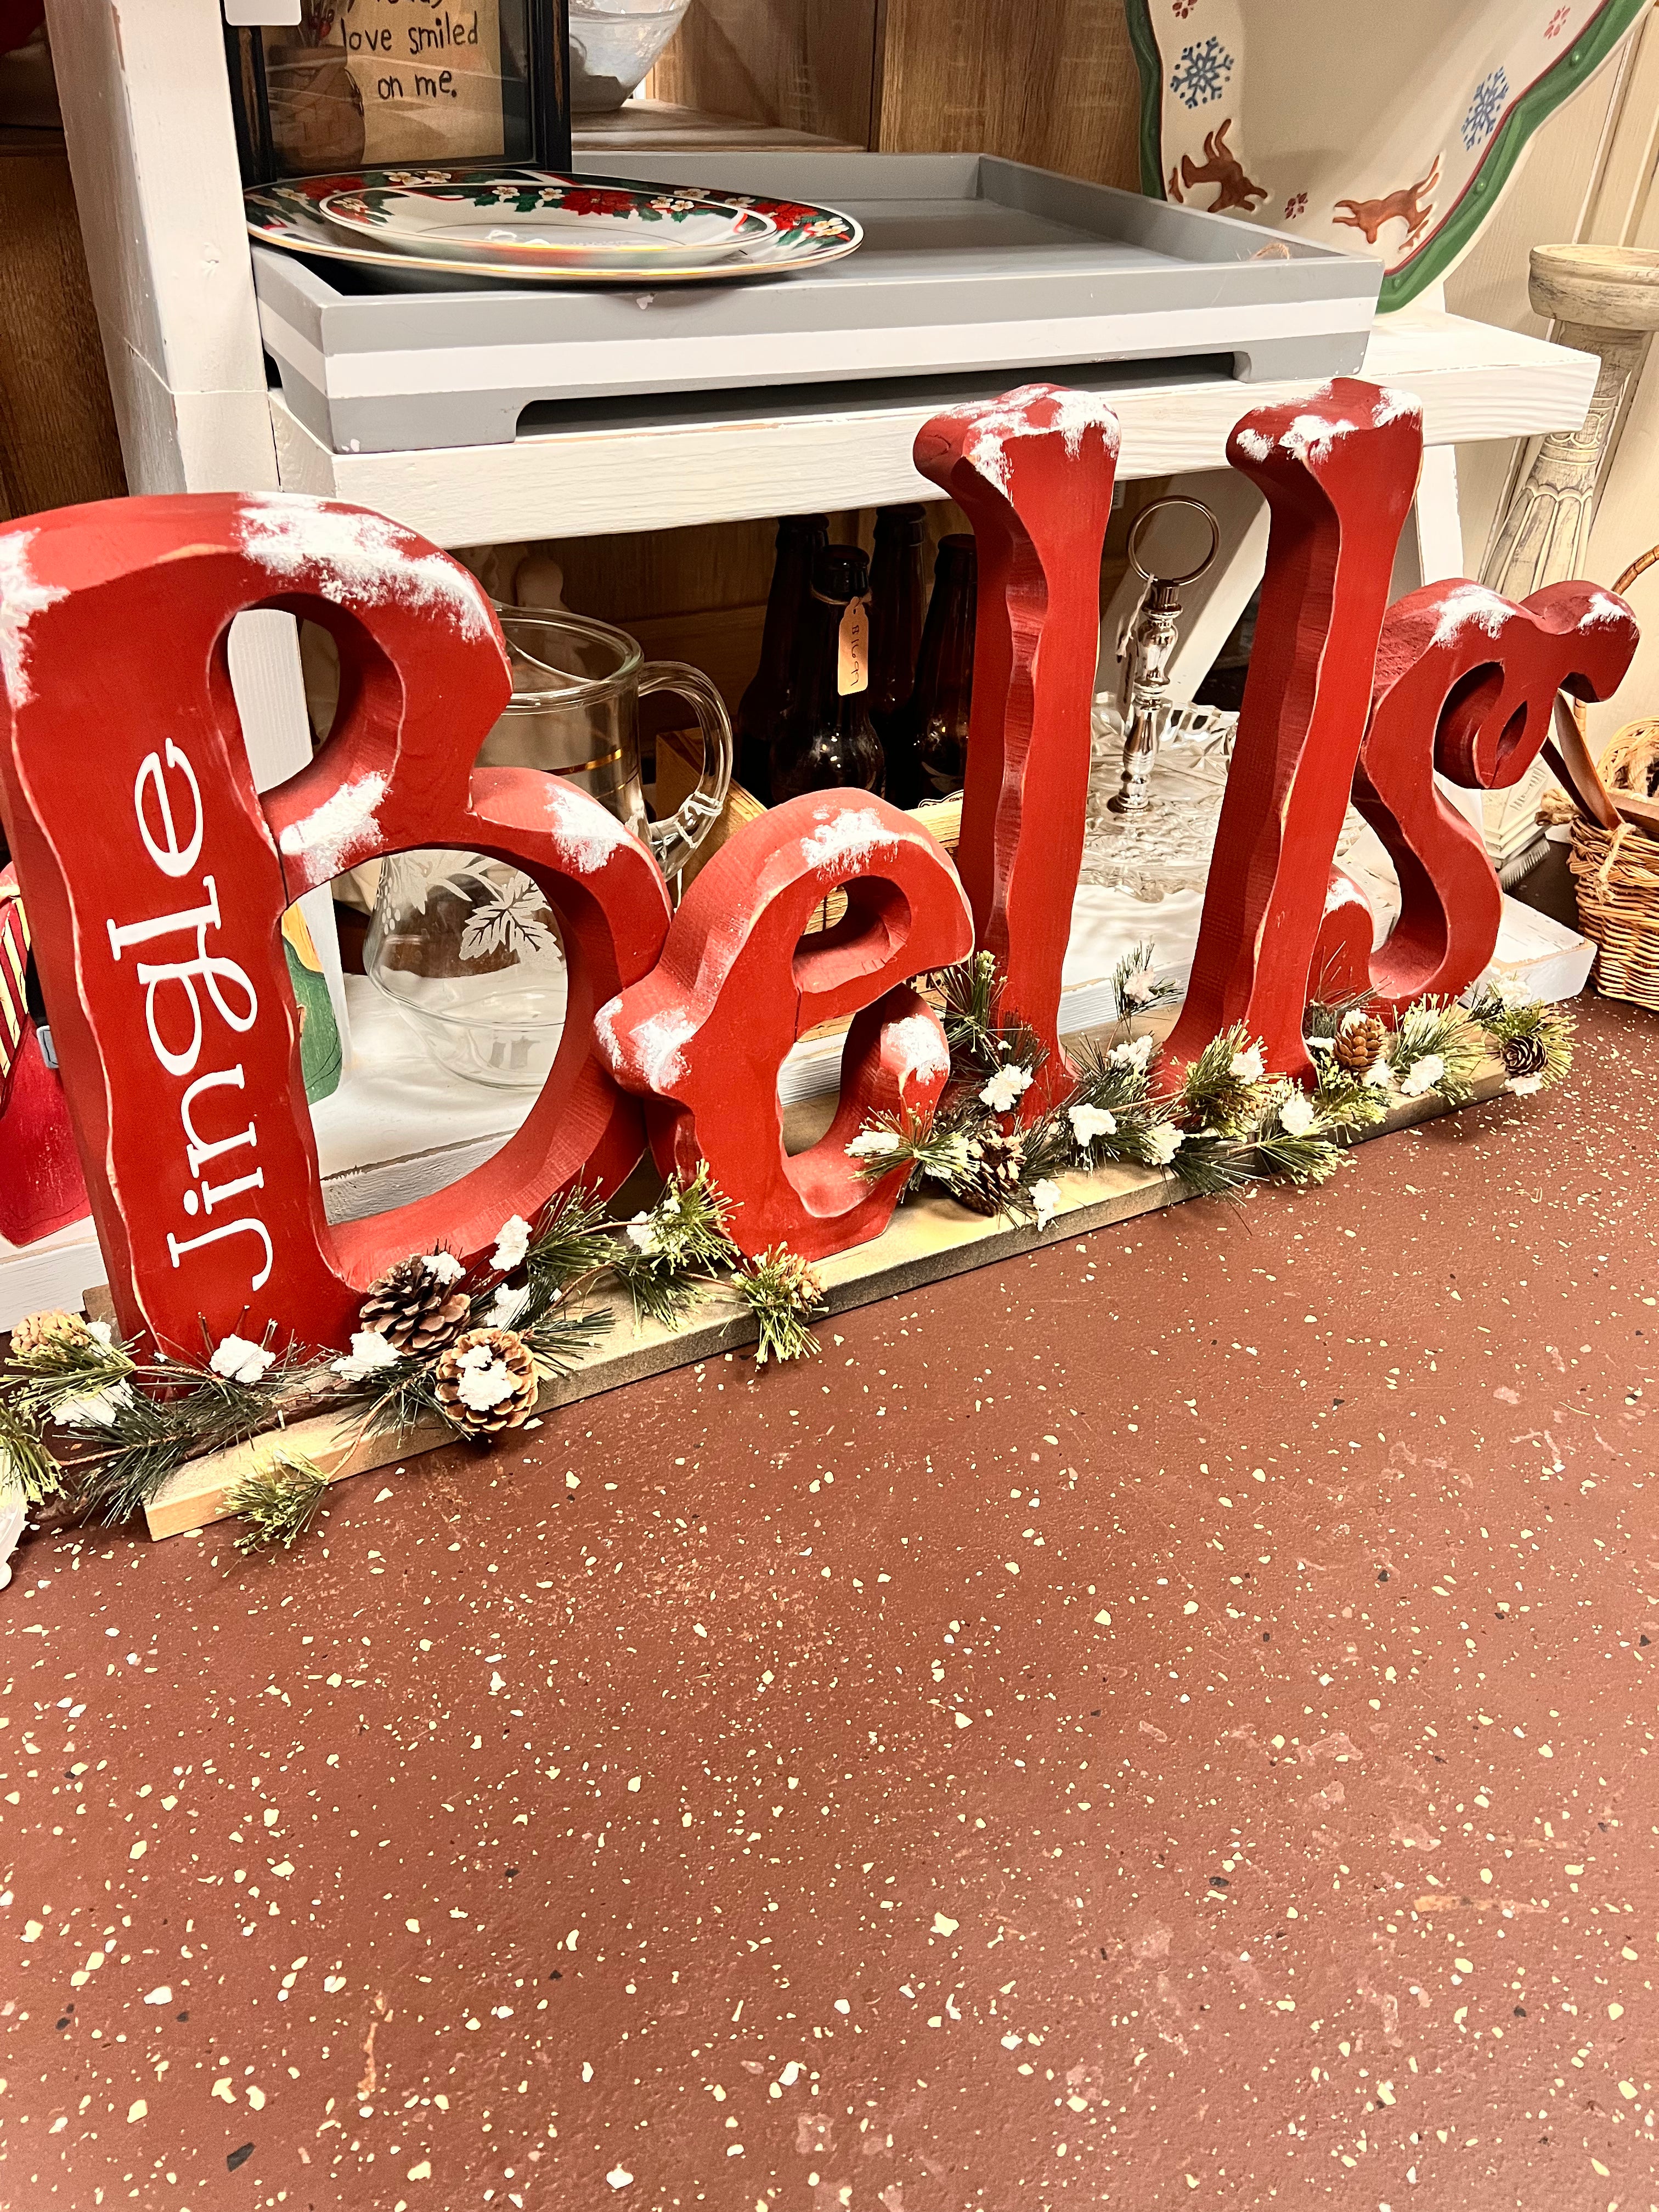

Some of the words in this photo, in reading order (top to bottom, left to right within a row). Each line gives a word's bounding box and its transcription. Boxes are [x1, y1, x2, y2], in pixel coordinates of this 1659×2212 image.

[341, 18, 392, 51] love
[408, 10, 478, 54] smiled
[378, 76, 403, 99] on
[415, 70, 457, 98] me.
[0, 377, 1639, 1402] Bells
